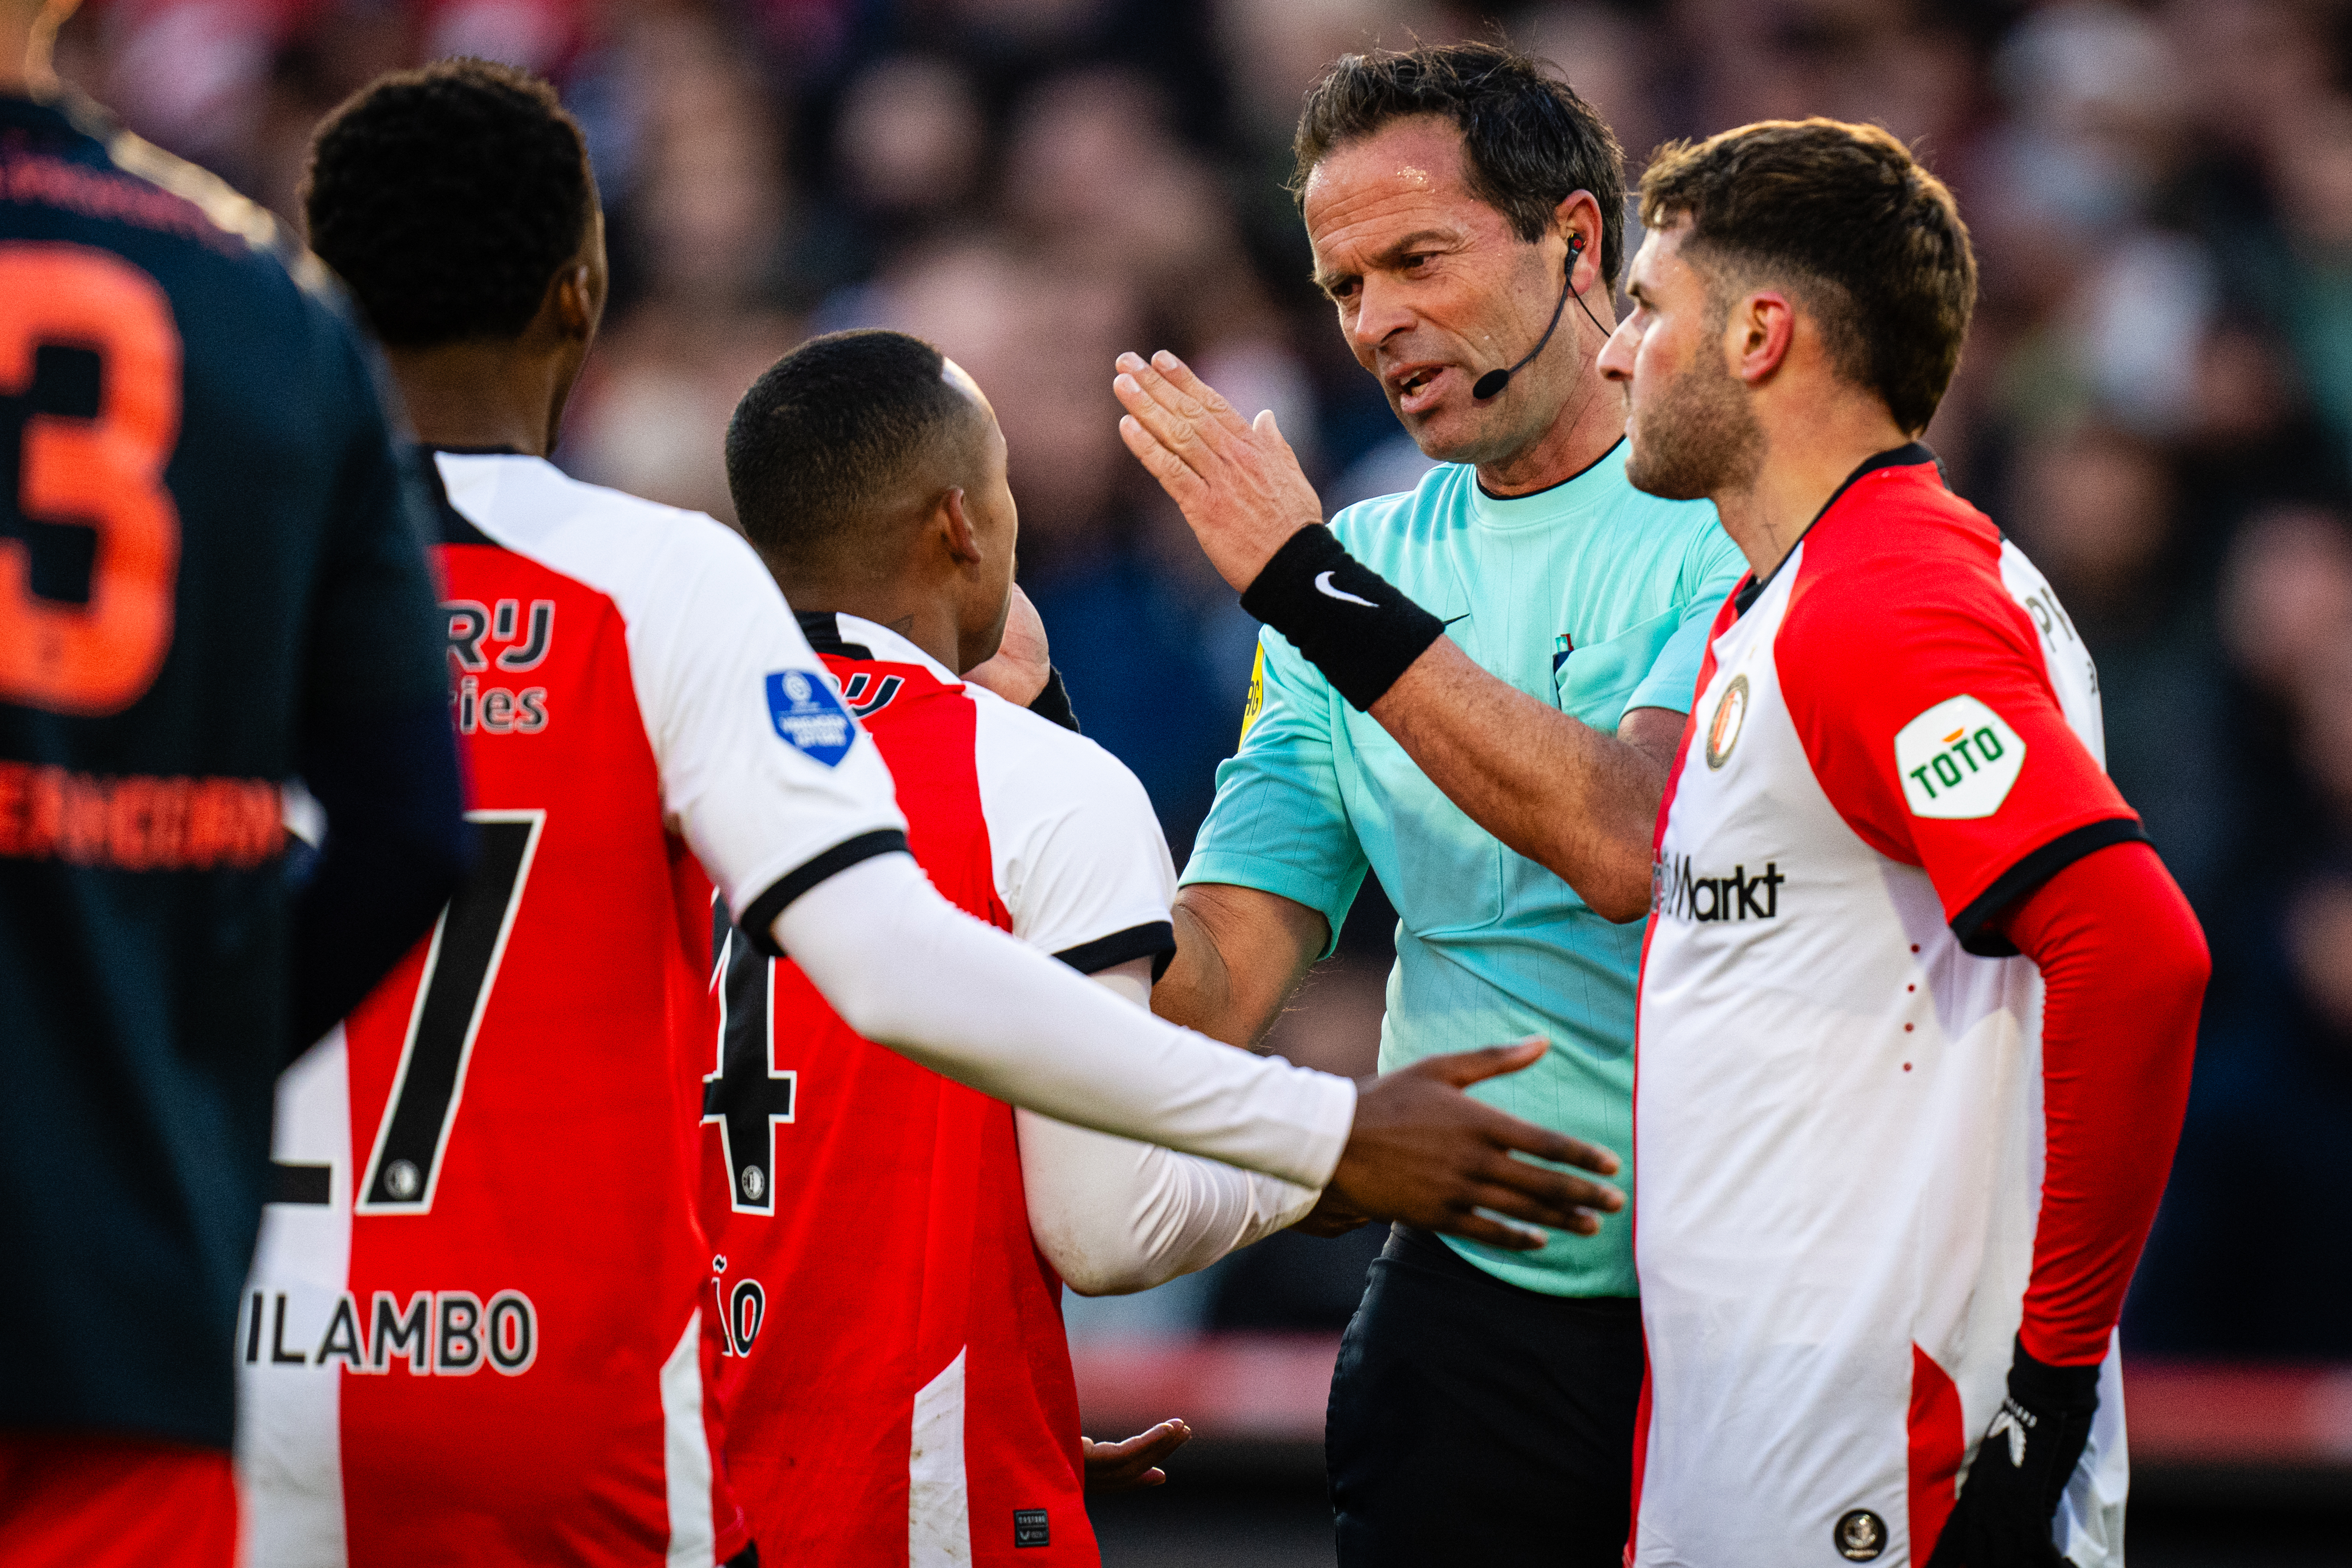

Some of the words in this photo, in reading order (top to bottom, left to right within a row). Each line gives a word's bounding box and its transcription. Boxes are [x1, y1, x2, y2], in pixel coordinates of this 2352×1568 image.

[449, 675, 549, 735] ies
[1910, 727, 2004, 798] TOTO
[1661, 850, 1785, 922] Markt
[268, 808, 547, 1216] 7
[244, 1290, 539, 1377] ILAMBO
